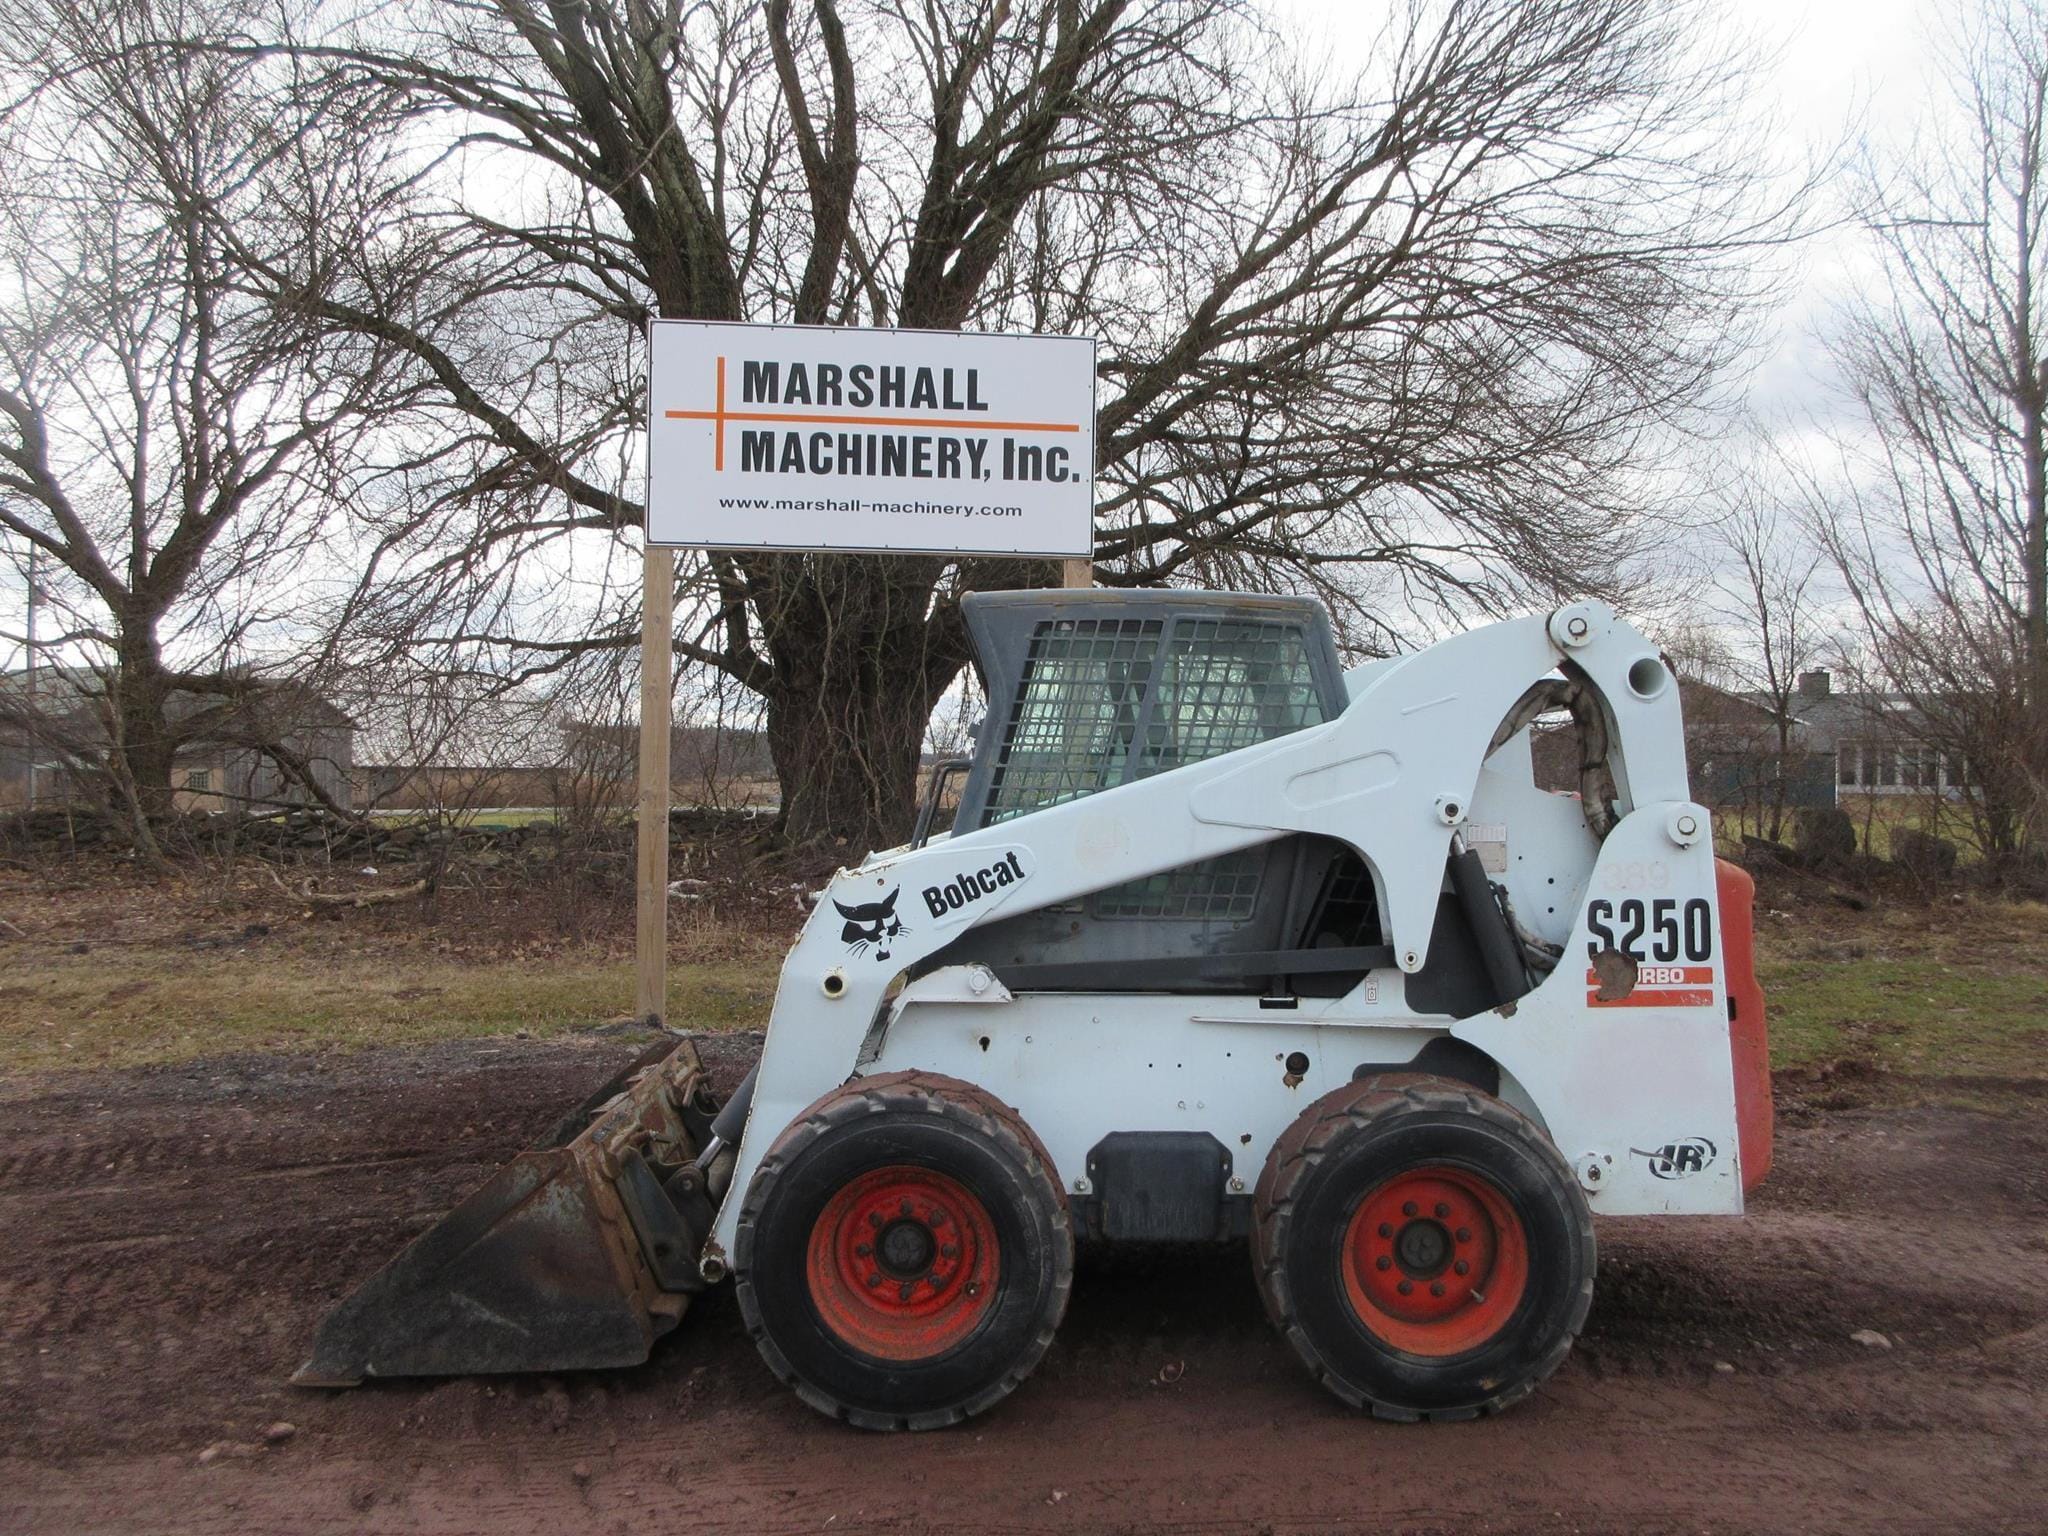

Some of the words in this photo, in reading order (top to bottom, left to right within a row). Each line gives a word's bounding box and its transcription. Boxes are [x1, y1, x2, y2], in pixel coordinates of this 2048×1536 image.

[742, 360, 988, 411] MARSHALL
[741, 430, 991, 483] MACHINERY,
[1003, 438, 1080, 483] Inc.
[719, 498, 1022, 518] www.marshall-machinery.com
[922, 851, 1025, 919] Bobcat
[1587, 898, 1711, 962] S250
[1637, 967, 1685, 984] RBO
